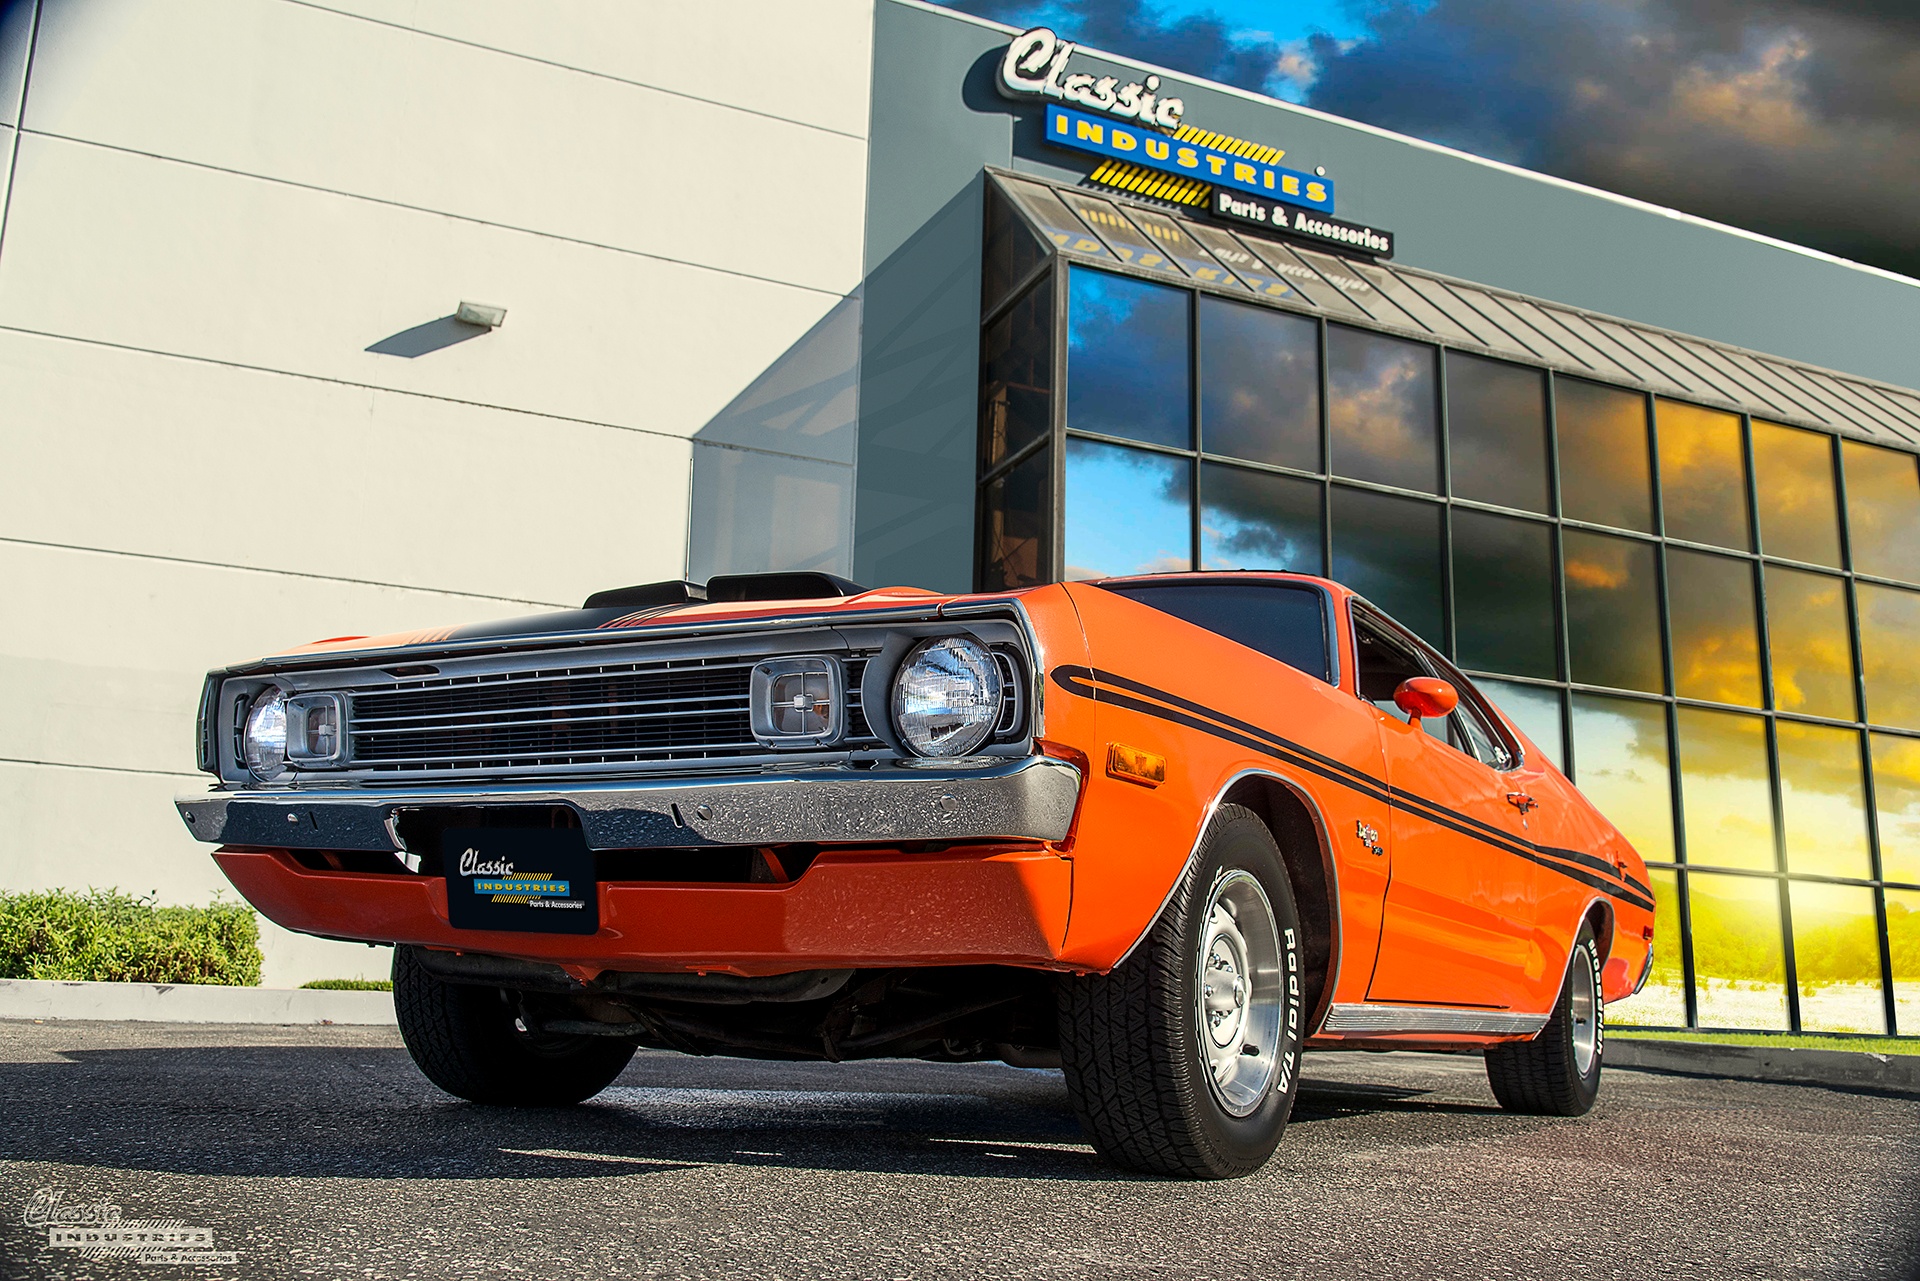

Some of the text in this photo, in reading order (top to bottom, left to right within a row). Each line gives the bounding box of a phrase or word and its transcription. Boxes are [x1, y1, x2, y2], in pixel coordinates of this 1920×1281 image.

[1003, 27, 1184, 128] Classic
[1056, 114, 1327, 203] INDUSTRIES
[1219, 193, 1389, 252] Parts & Accessories
[459, 848, 514, 876] Classic
[477, 883, 566, 892] INDUSTRIES
[530, 900, 583, 909] Parts & Accessories
[1277, 928, 1300, 1094] Radial T/A
